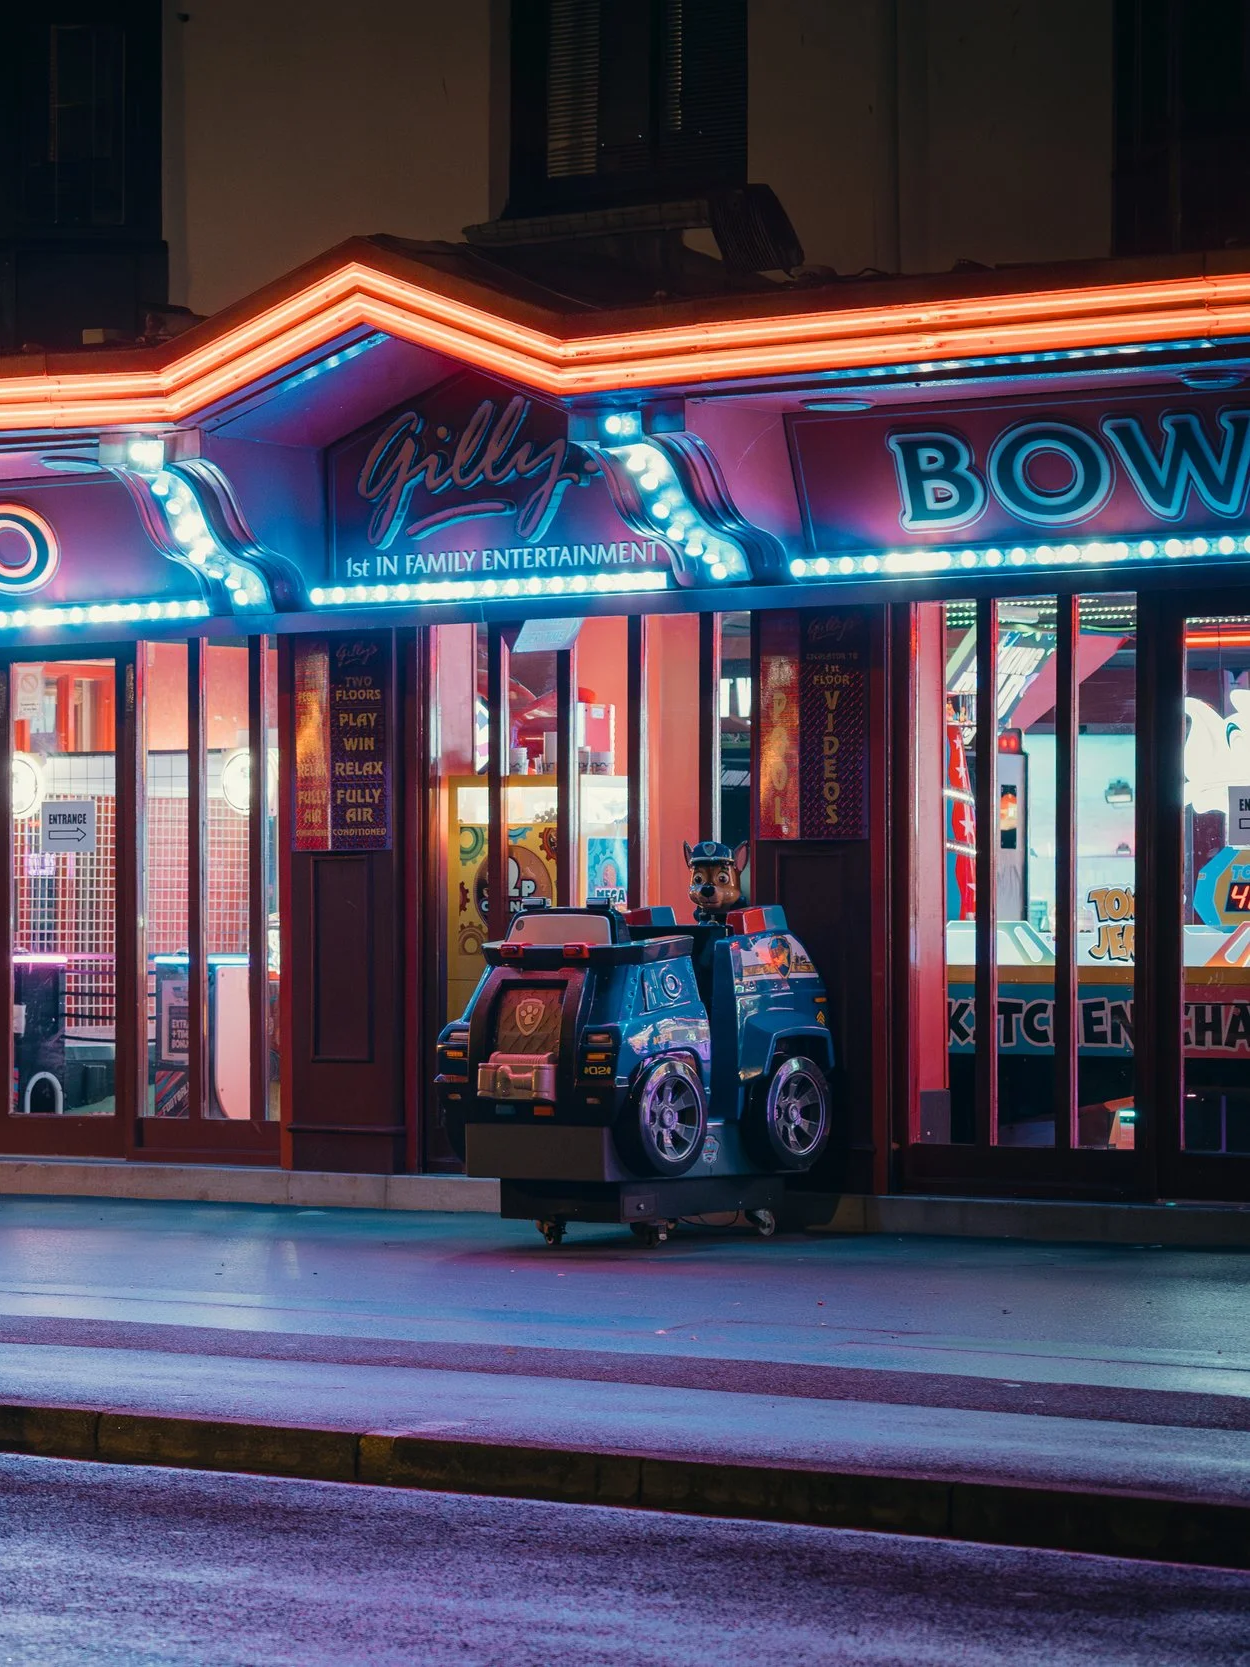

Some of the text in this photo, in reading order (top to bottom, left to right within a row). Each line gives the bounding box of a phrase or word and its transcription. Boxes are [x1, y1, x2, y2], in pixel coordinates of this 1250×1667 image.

[886, 408, 1250, 533] BOW
[346, 541, 659, 577] 1st IN FAMILY ENTERTAINMENT
[345, 676, 372, 688] TWO
[813, 674, 850, 686] FLOOR
[336, 689, 382, 701] FLOORS
[338, 713, 378, 727] PLAY
[343, 737, 374, 751] WIN
[823, 690, 841, 824] VIDEOS
[335, 761, 383, 776] RELAX
[336, 790, 382, 804] FULLY
[48, 813, 87, 825] ENTRANCE
[345, 808, 374, 823] AIR
[333, 828, 387, 836] CONDITIONED
[1231, 885, 1250, 909] 4
[172, 1019, 189, 1029] EXTR
[948, 999, 1250, 1051] KTCEN HA
[172, 1039, 189, 1049] BONU
